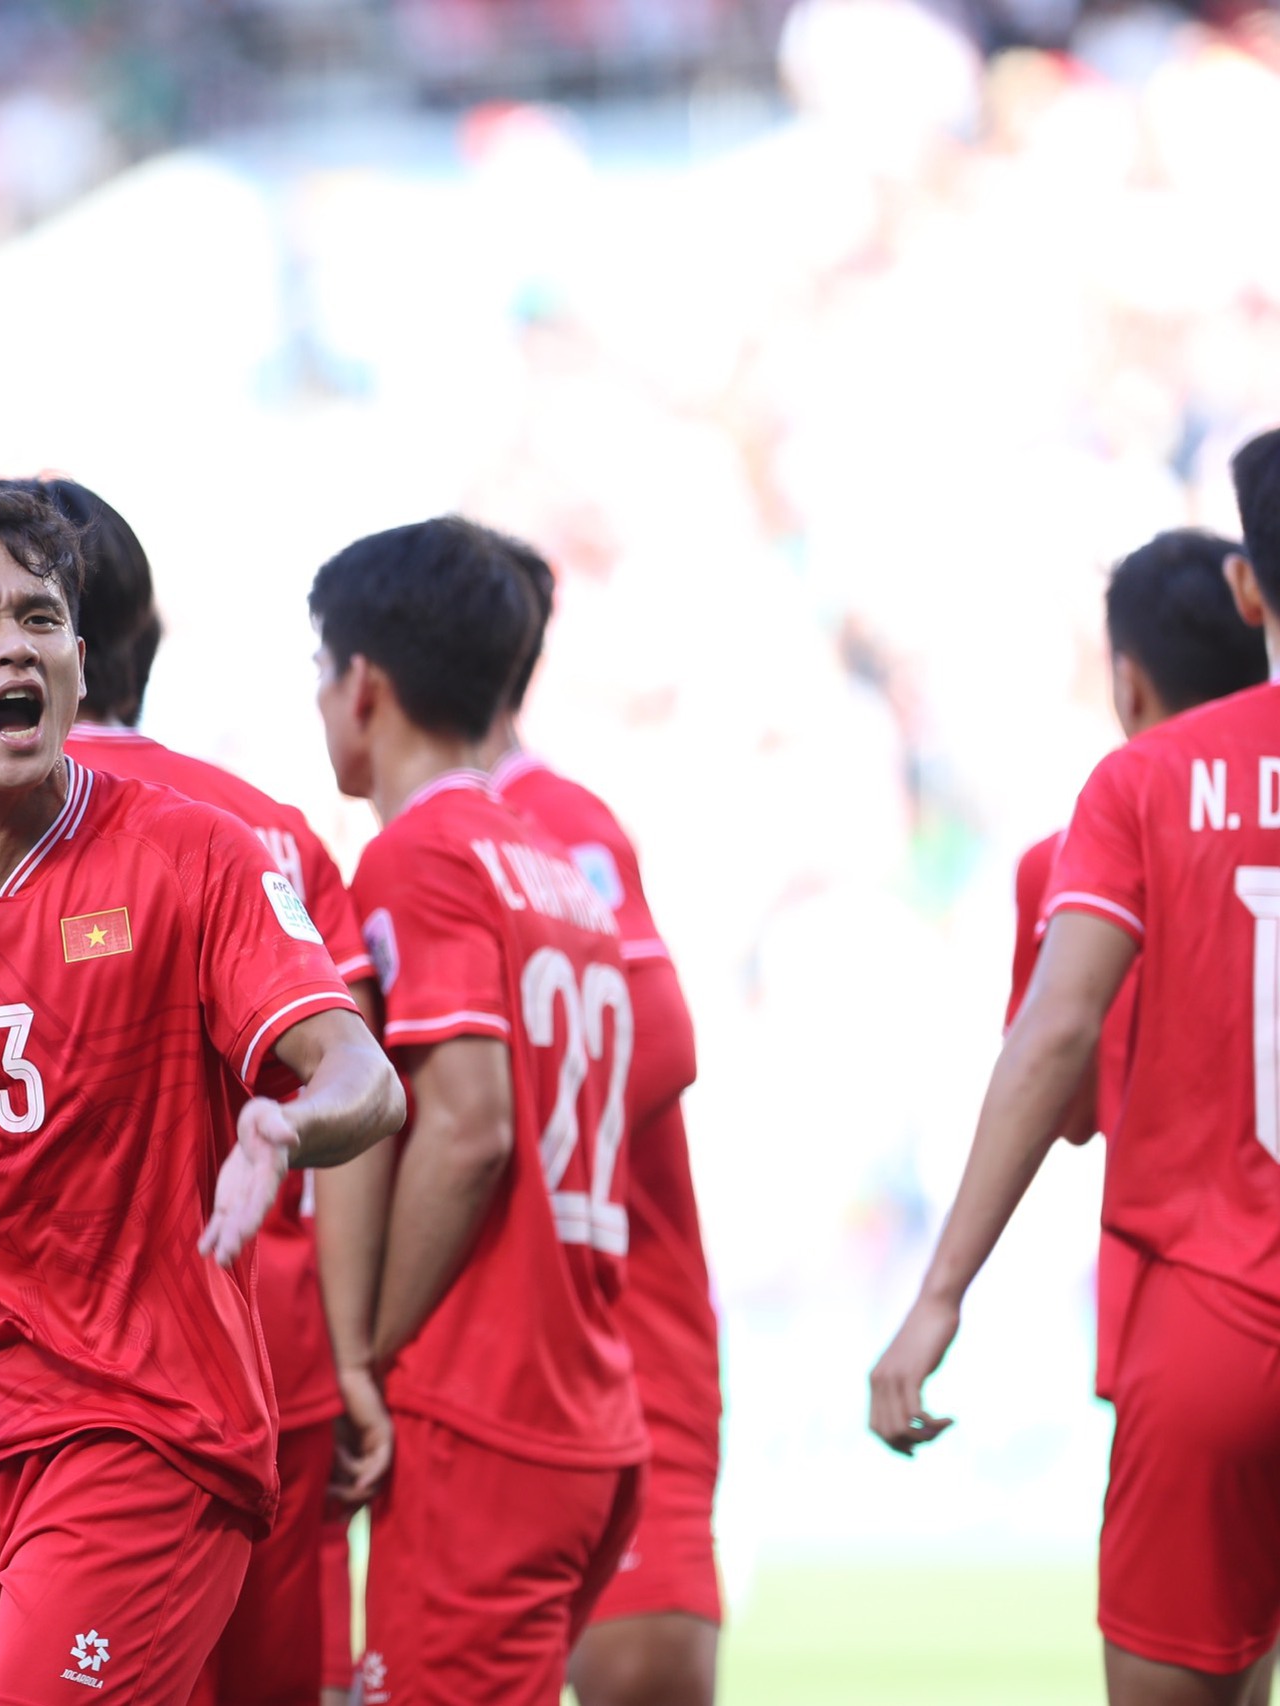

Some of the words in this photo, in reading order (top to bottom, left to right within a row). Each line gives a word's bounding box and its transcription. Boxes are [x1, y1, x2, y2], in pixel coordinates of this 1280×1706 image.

[1189, 758, 1241, 832] N.
[272, 881, 290, 894] AFC
[520, 945, 634, 1258] 22
